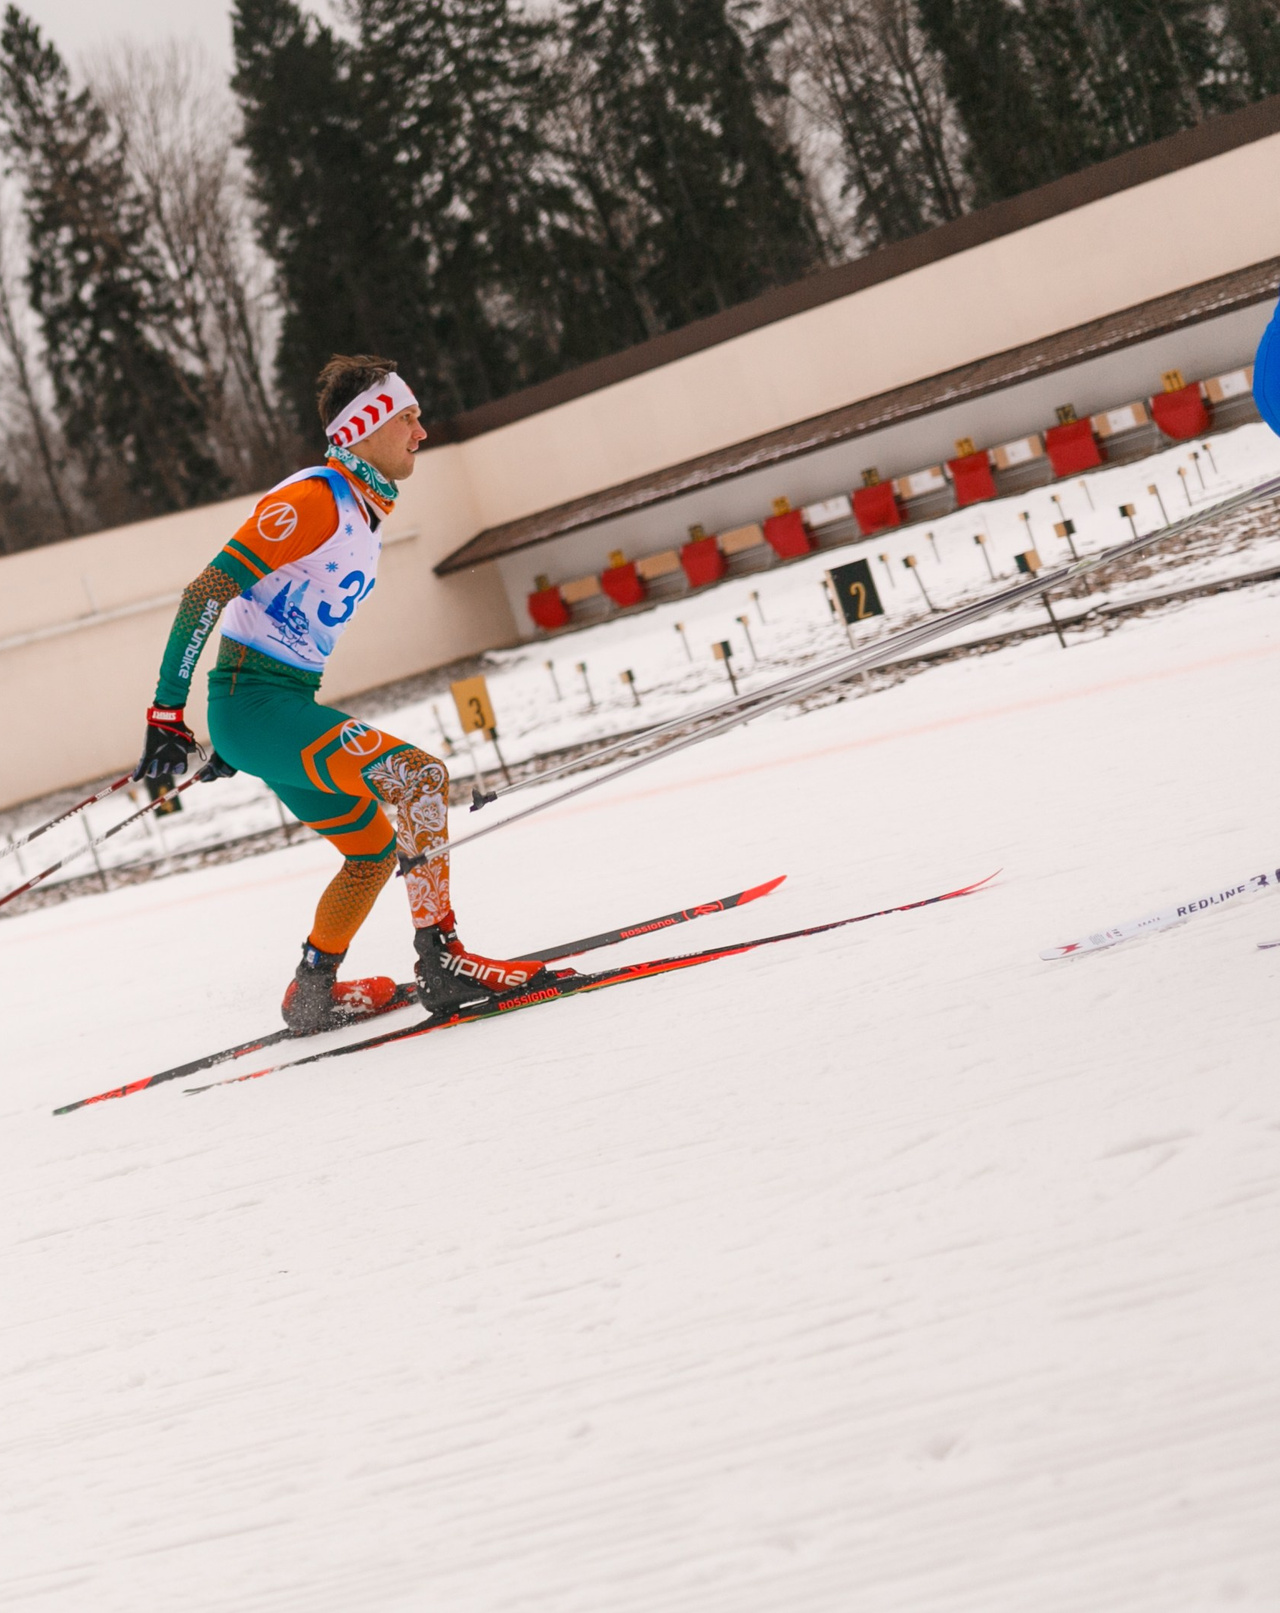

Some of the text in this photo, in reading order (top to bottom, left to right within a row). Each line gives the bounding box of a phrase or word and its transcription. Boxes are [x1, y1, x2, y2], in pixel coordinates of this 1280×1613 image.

[849, 582, 873, 619] 2
[178, 599, 219, 679] skirunbike
[468, 698, 486, 728] 3
[440, 951, 528, 987] alpina
[497, 986, 563, 1012] ROSSIGNOL
